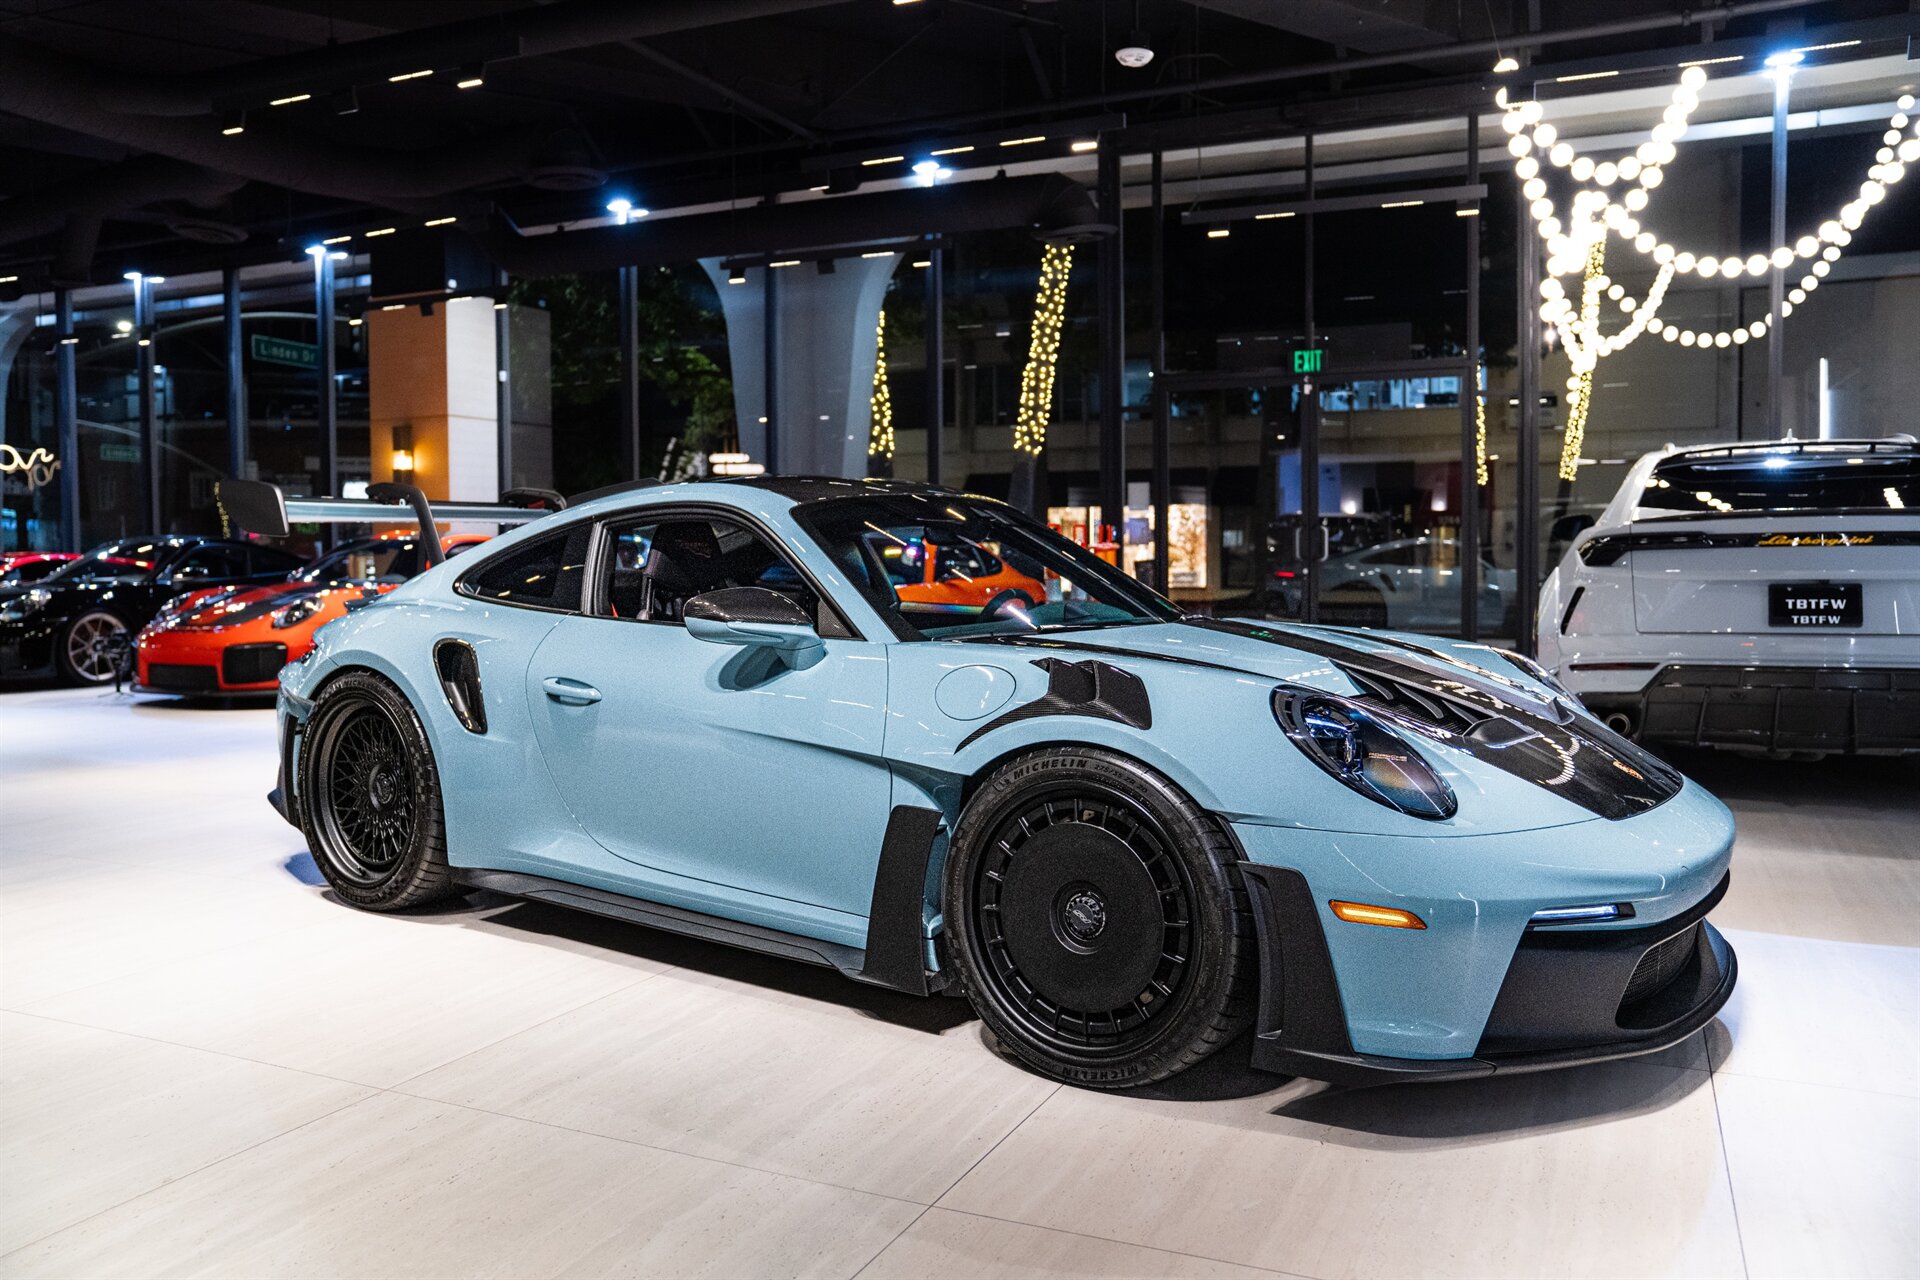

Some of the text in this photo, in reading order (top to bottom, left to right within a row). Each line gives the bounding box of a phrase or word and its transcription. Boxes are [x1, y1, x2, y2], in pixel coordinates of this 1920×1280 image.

[260, 342, 316, 363] Linden Dr
[1294, 349, 1323, 373] EXIT
[1785, 598, 1847, 610] TBTFW
[1791, 615, 1841, 625] TBTFW
[1013, 758, 1088, 780] MICHELIN
[1062, 1064, 1139, 1080] MICHELIN
